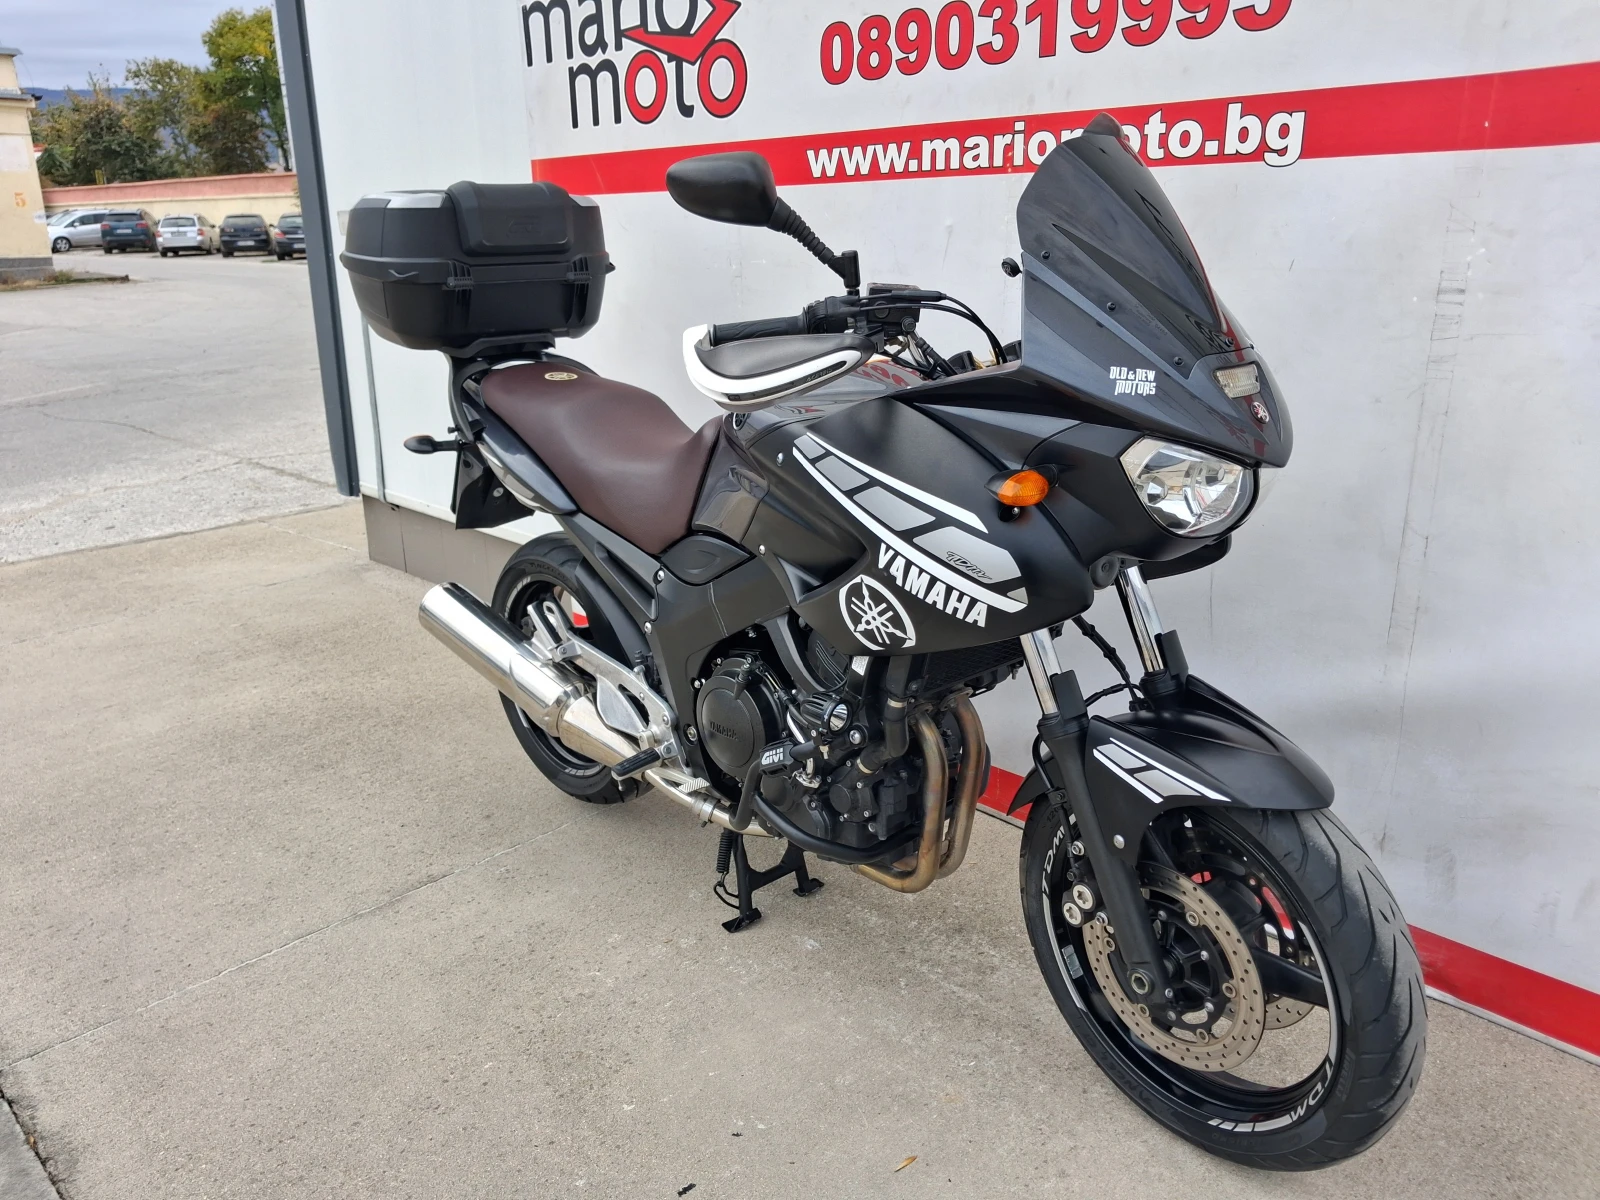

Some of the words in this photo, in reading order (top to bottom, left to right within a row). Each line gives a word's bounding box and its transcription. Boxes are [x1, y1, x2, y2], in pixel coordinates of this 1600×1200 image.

[568, 38, 748, 129] moto
[806, 102, 1306, 180] www.marioto.bg
[1109, 366, 1128, 379] OLD
[1135, 368, 1156, 382] NEW
[1114, 380, 1157, 396] MOTORS
[878, 542, 988, 628] YAMAHA
[1042, 825, 1066, 895] TDM
[1291, 1060, 1334, 1122] TDM
